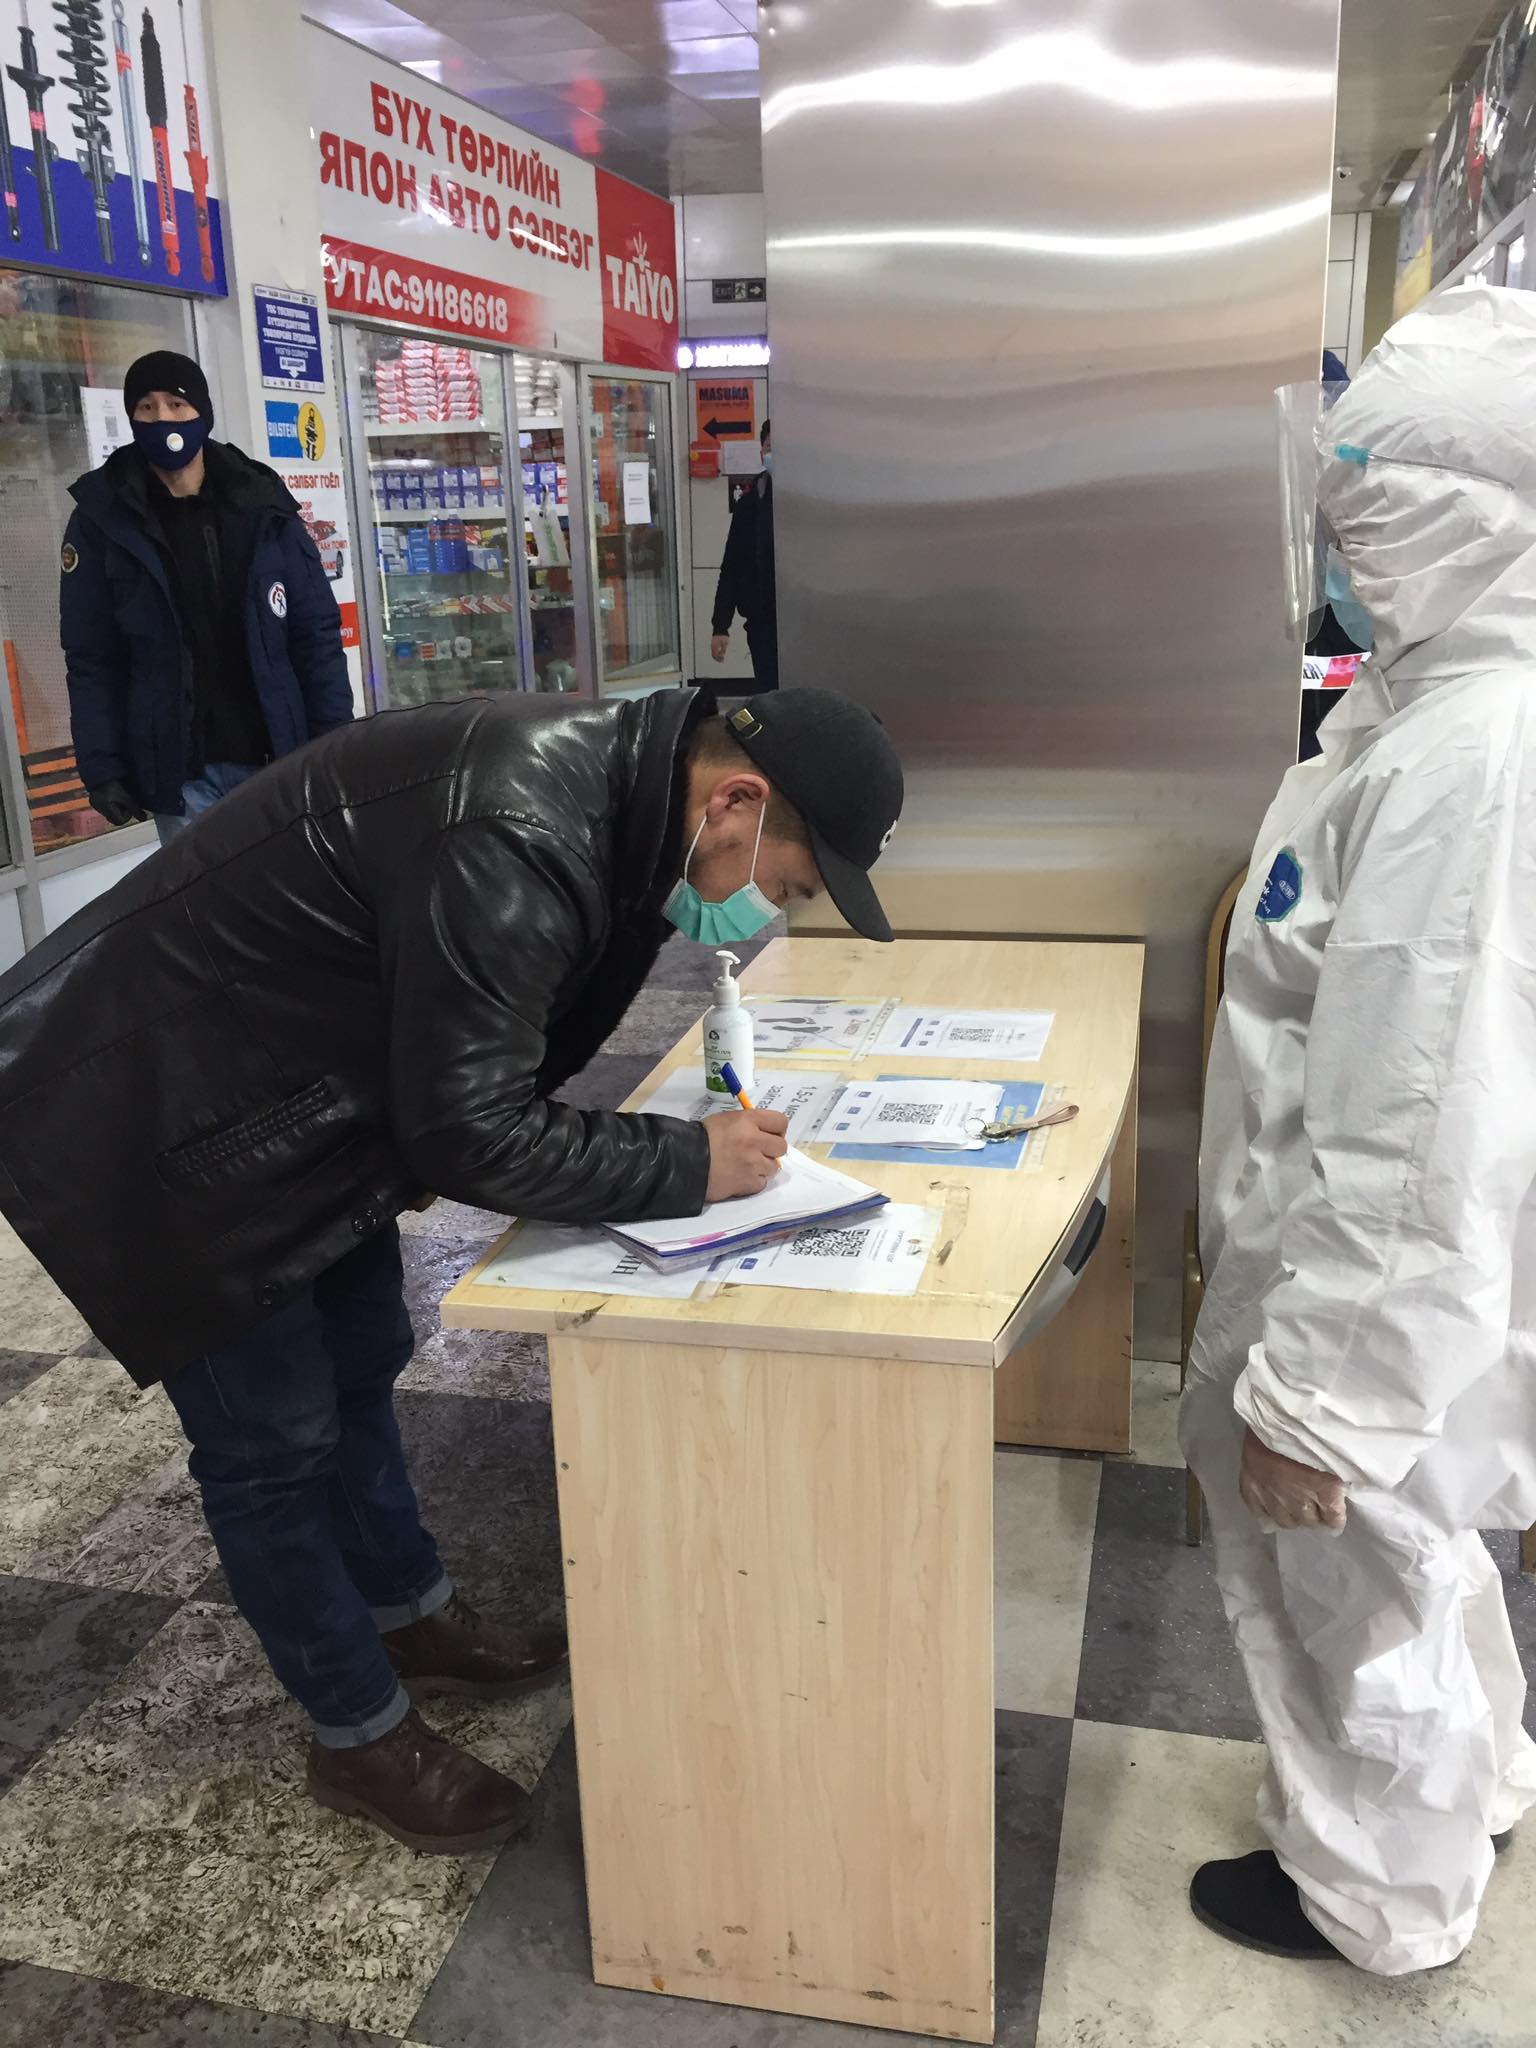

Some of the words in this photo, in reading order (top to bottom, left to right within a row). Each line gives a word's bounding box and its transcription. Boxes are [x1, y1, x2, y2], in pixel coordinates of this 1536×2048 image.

[319, 131, 418, 214] ЯПОН
[429, 173, 500, 241] АВТО
[508, 204, 594, 271] СЭЛБЭГ
[370, 81, 436, 156] БҮХ
[439, 113, 560, 209] ТӨРЛИЙН
